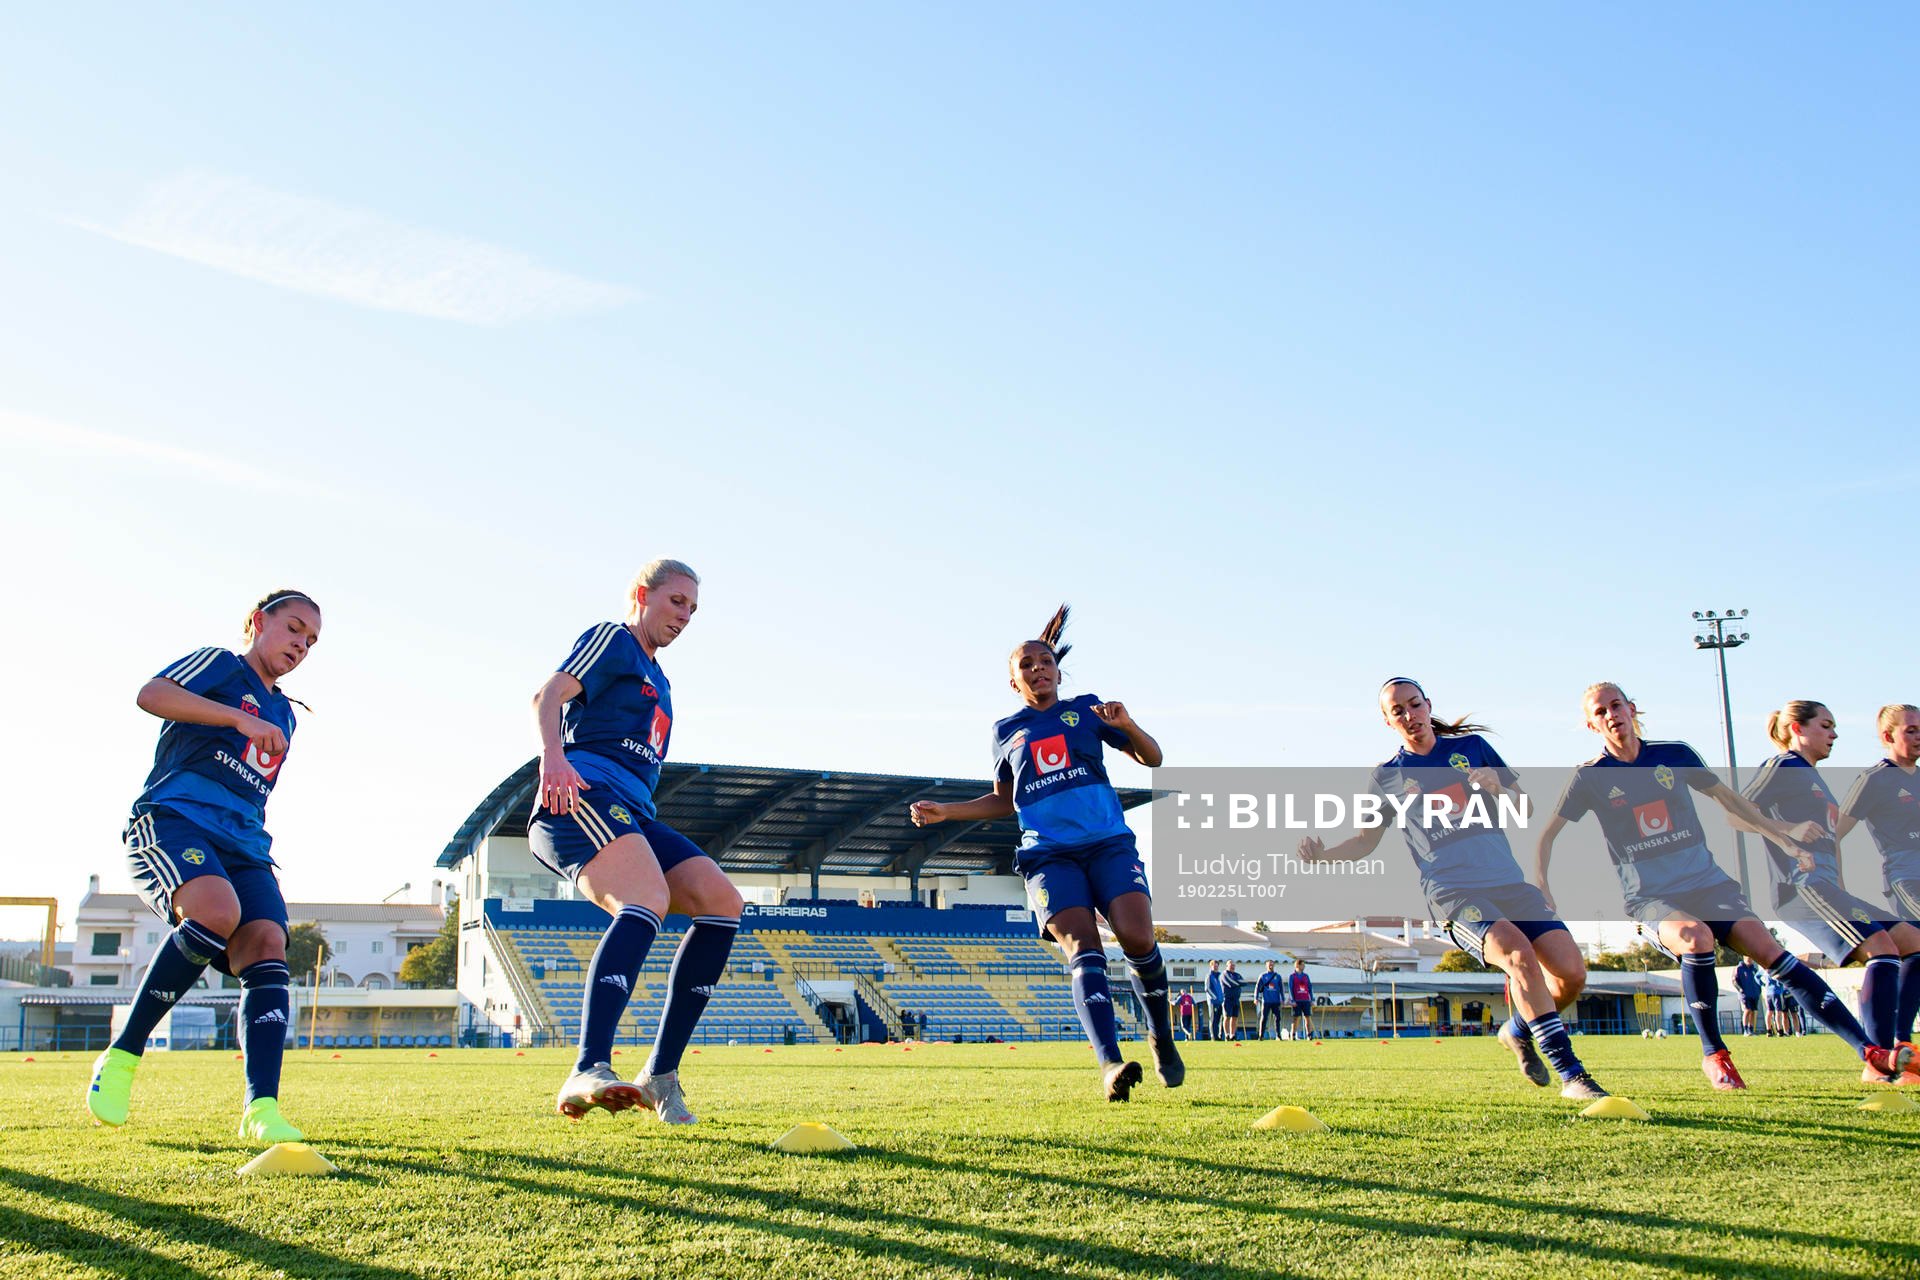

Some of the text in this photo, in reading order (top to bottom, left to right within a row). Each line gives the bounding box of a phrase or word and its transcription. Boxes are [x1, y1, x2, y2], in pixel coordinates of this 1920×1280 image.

[214, 750, 260, 789] SVENSKA
[1025, 767, 1088, 794] SVENSKA SPEL
[1626, 829, 1692, 854] SVENSKA SPEL
[759, 906, 827, 917] FERREIRAS
